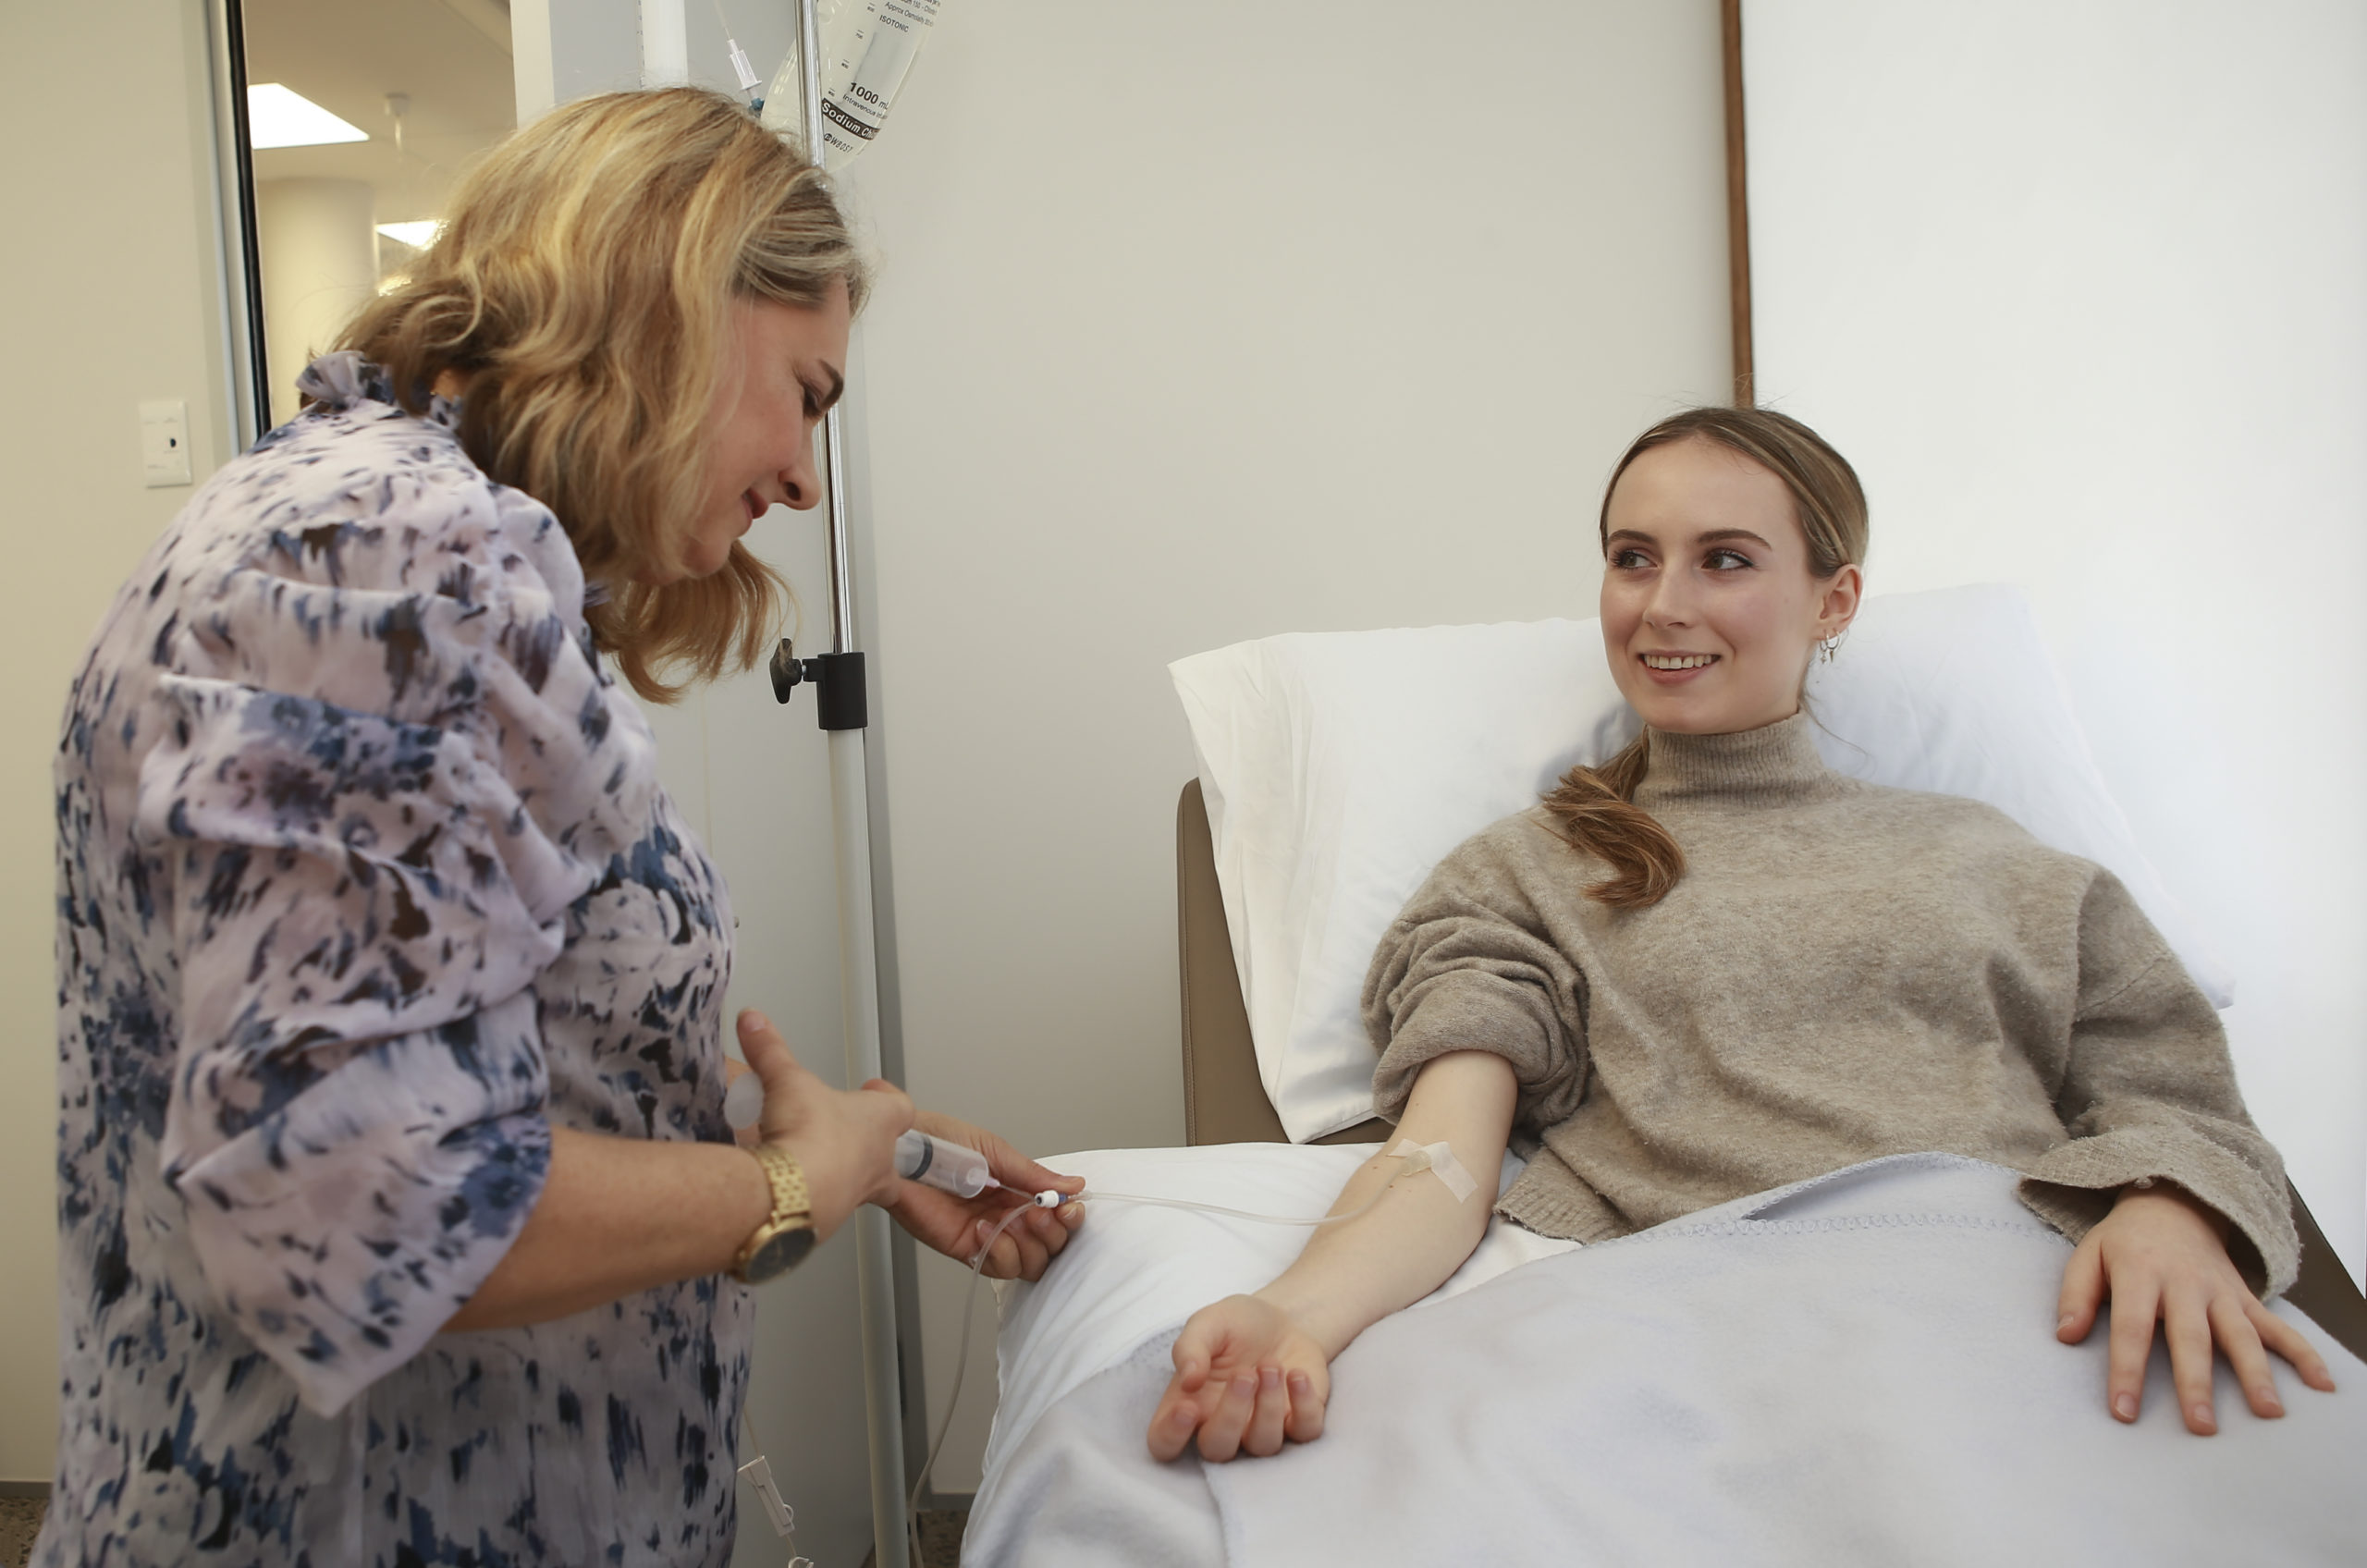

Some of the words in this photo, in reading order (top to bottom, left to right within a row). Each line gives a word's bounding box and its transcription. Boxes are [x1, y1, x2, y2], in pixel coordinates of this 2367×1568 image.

[885, 2, 904, 15] Approx
[879, 14, 909, 32] ISOTONIC
[851, 82, 878, 104] 1000
[822, 102, 861, 134] Sodium
